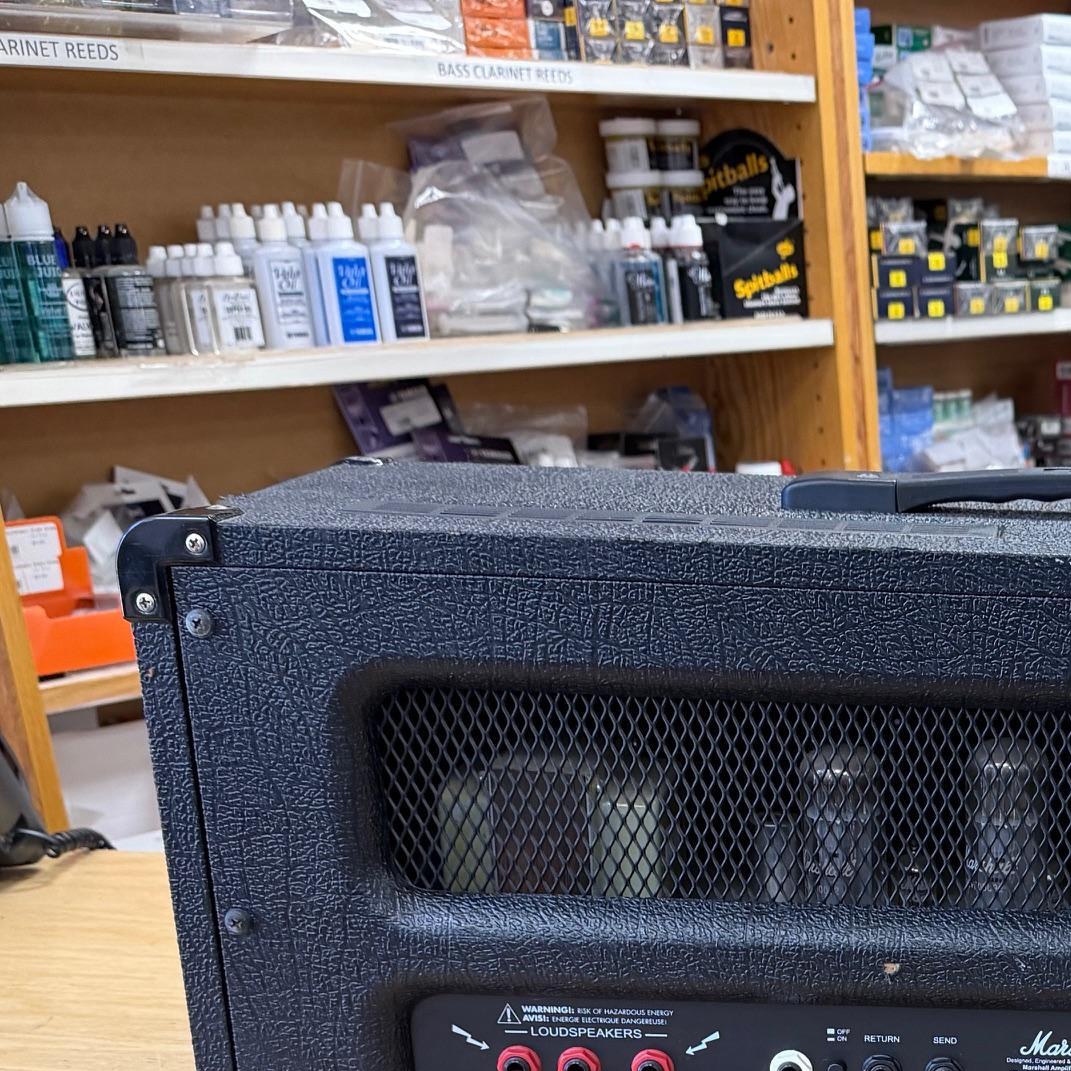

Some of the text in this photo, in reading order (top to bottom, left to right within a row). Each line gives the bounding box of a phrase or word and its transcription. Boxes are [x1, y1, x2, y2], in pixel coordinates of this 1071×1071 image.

[65, 42, 119, 61] REEDS
[438, 62, 574, 84] BASS CLARINET REEDS
[701, 152, 769, 199] pitballs
[26, 254, 57, 266] BLUE
[734, 262, 799, 300] Spitballs
[521, 1005, 575, 1015] WARNING!:
[604, 1008, 646, 1016] HAZARDOUS
[647, 1009, 675, 1017] ENERGY
[552, 1016, 580, 1024] ENERGIE
[582, 1016, 619, 1025] ELECTRIQUE
[530, 1026, 643, 1039] LOUDSPEAKERS
[864, 1034, 900, 1043] RETURN
[933, 1036, 957, 1045] SEND
